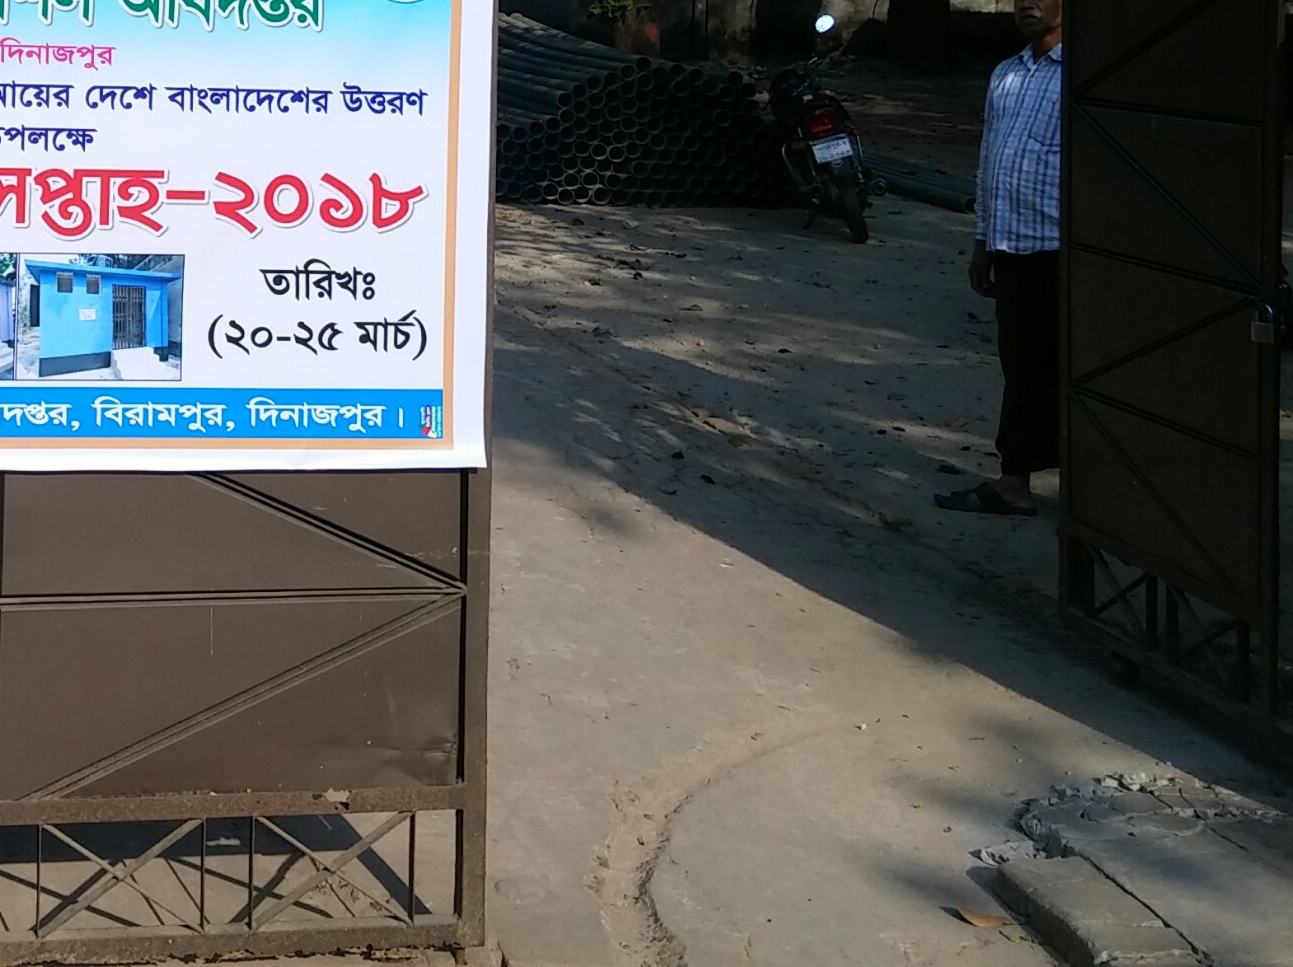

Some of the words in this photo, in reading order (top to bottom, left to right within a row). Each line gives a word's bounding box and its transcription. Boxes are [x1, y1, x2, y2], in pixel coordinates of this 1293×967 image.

[85, 82, 158, 111] দেশে
[167, 84, 334, 115] বাংলাদেশের
[340, 82, 429, 117] উত্তরণ
[260, 258, 376, 301] তারিখঃ
[207, 313, 344, 360] (২০-২৫
[355, 310, 428, 361] মার্চ)
[91, 396, 236, 432] বিরামপুর,
